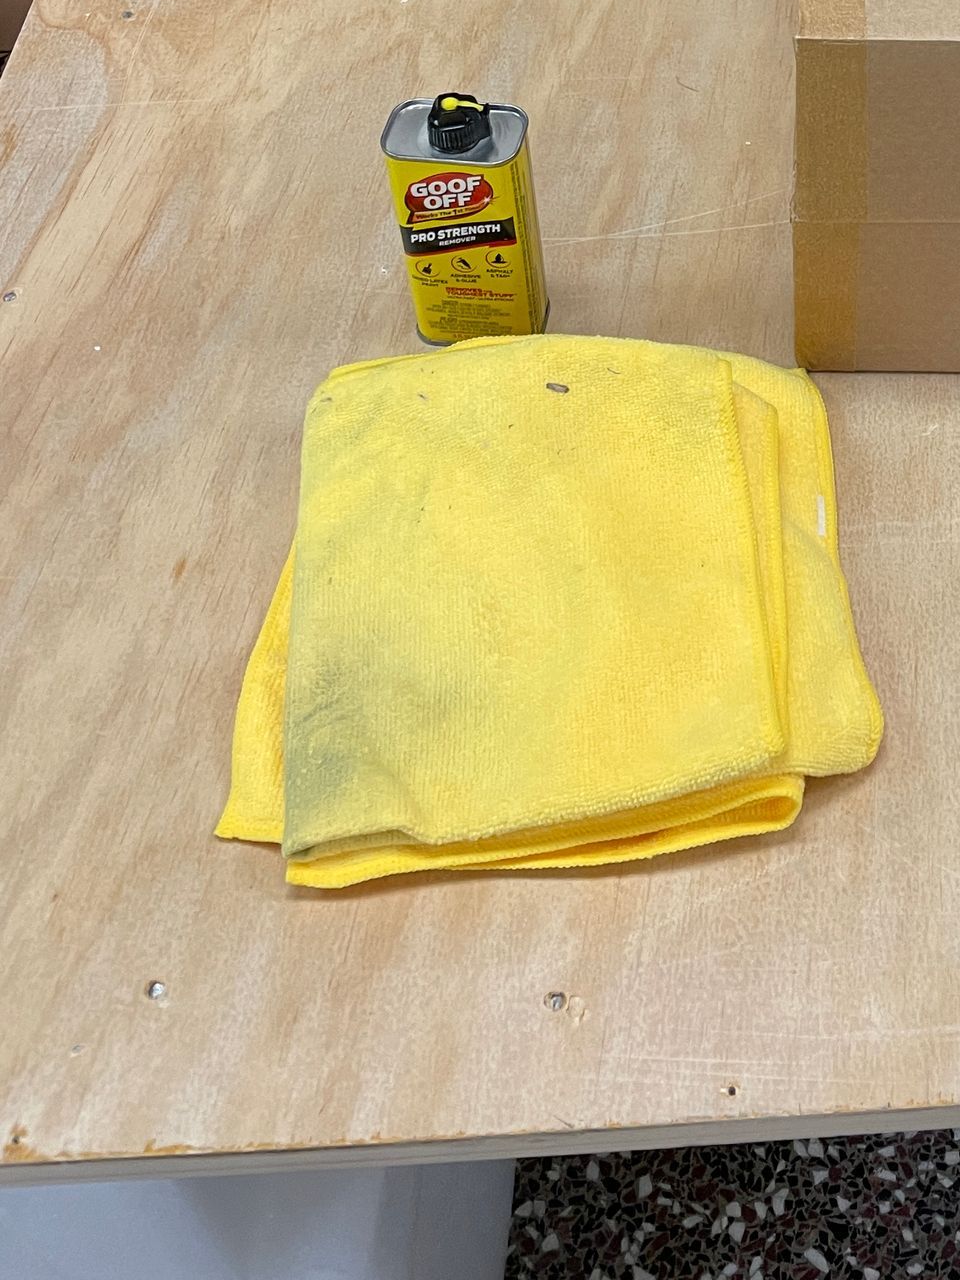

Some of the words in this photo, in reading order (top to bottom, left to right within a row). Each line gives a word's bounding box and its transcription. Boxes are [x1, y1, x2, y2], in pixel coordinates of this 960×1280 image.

[410, 176, 481, 197] GOOF
[423, 192, 472, 209] OFF
[411, 233, 436, 243] PRO
[437, 224, 501, 240] STRENGTH
[439, 236, 476, 246] REMOVER
